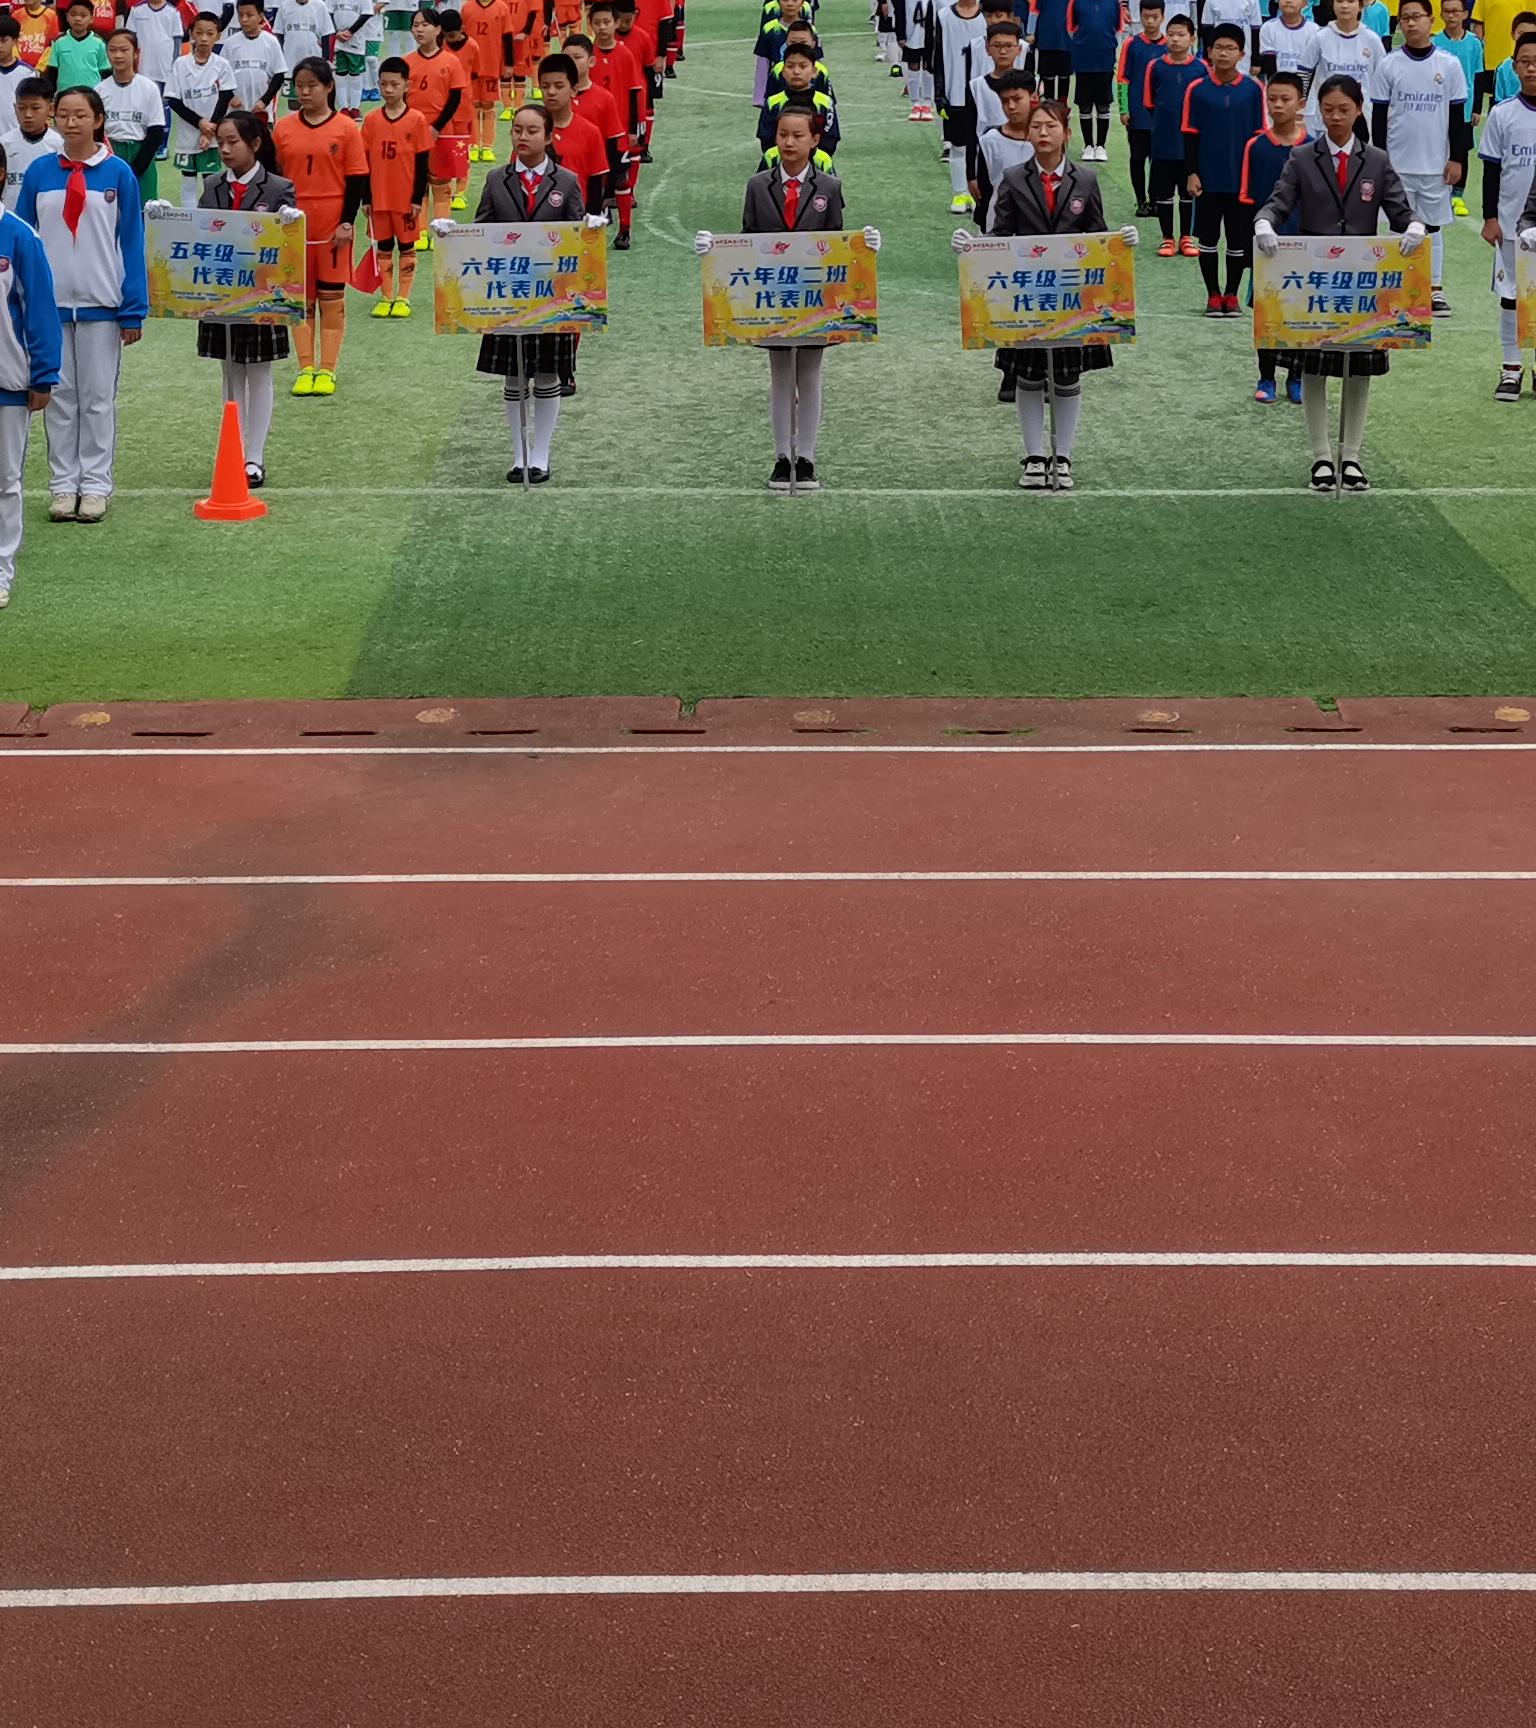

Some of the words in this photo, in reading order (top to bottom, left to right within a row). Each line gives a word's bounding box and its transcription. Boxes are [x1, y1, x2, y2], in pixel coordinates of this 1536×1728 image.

[477, 22, 489, 36] 12
[419, 75, 428, 90] 6
[1397, 92, 1443, 103] Emirates
[381, 141, 397, 160] 15
[306, 154, 313, 176] 1
[169, 241, 281, 265] 五年级一班
[461, 256, 579, 276] 六年级一班
[729, 265, 848, 286] 六年级二班
[192, 266, 256, 288] 代表队
[987, 268, 1106, 290] 六年级三班
[1282, 271, 1403, 289] 六年级四班
[486, 279, 555, 299] 代表队
[755, 289, 824, 309] 代表队
[1013, 292, 1082, 312] 代表队
[1307, 295, 1379, 314] 代表队
